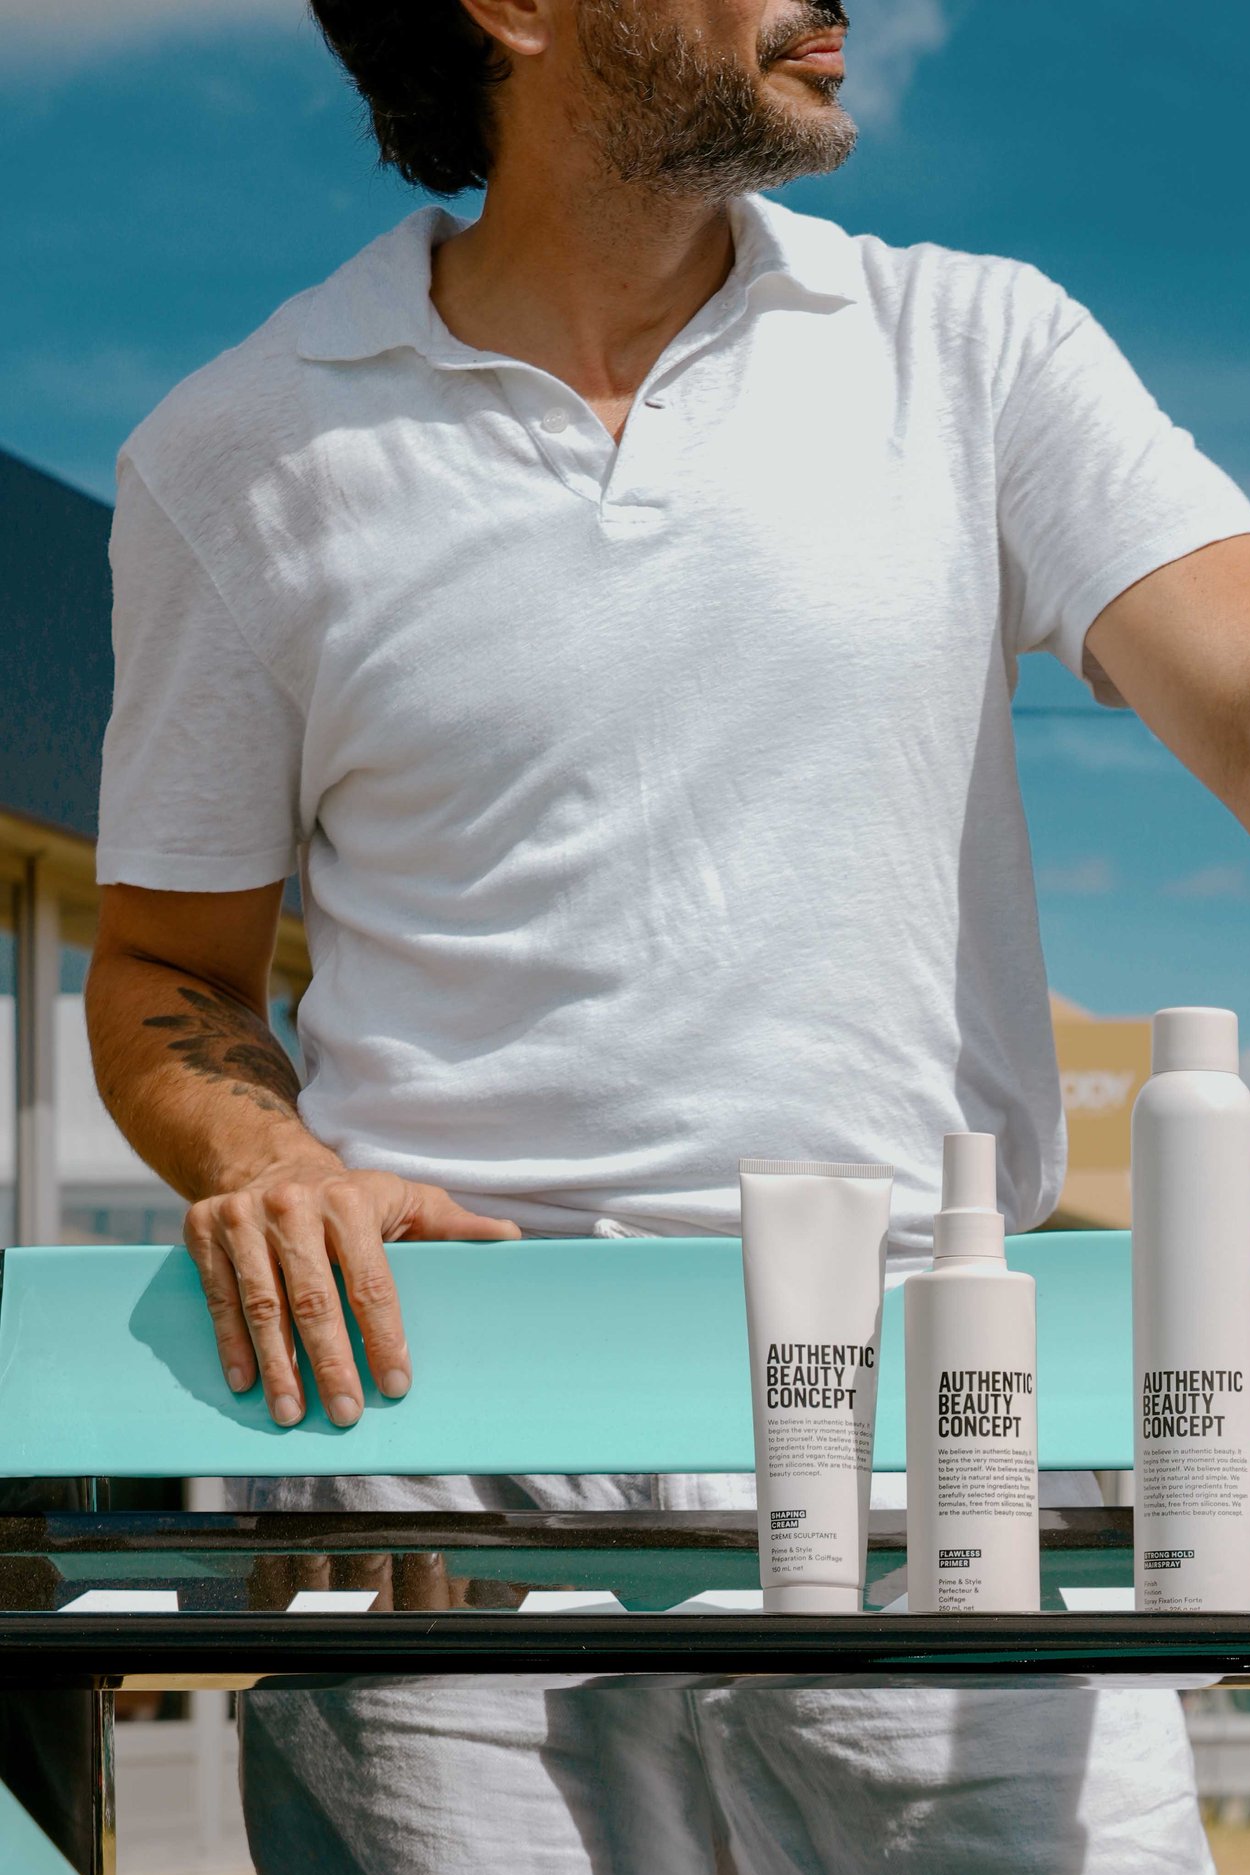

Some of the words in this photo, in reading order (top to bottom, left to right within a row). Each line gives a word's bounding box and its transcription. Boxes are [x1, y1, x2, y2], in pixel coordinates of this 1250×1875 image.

[767, 1344, 874, 1368] AUTHENTIC
[767, 1366, 845, 1387] BEAUTY
[939, 1371, 1032, 1394] AUTHENTIC
[1143, 1371, 1242, 1394] AUTHENTIC
[767, 1387, 856, 1409] CONCEPT
[939, 1393, 1013, 1415] BEAUTY
[1143, 1393, 1214, 1416] BEAUTY
[768, 1427, 789, 1435] begins
[939, 1416, 1021, 1438] CONCEPT
[1143, 1416, 1225, 1439] CONCEPT
[1214, 1448, 1236, 1456] beauty.
[938, 1457, 959, 1465] begins
[956, 1465, 983, 1473] yourself.
[1206, 1474, 1229, 1482] simple.
[987, 1483, 1019, 1491] ingredients
[1185, 1483, 1222, 1491] ingredients
[771, 1511, 805, 1519] SHAPING
[771, 1521, 798, 1529] CREAM
[940, 1550, 980, 1558] FLAWLESS
[1144, 1552, 1169, 1560] STRONG
[815, 1554, 843, 1563] Coiffage
[1144, 1561, 1180, 1569] HAIRSPRAY
